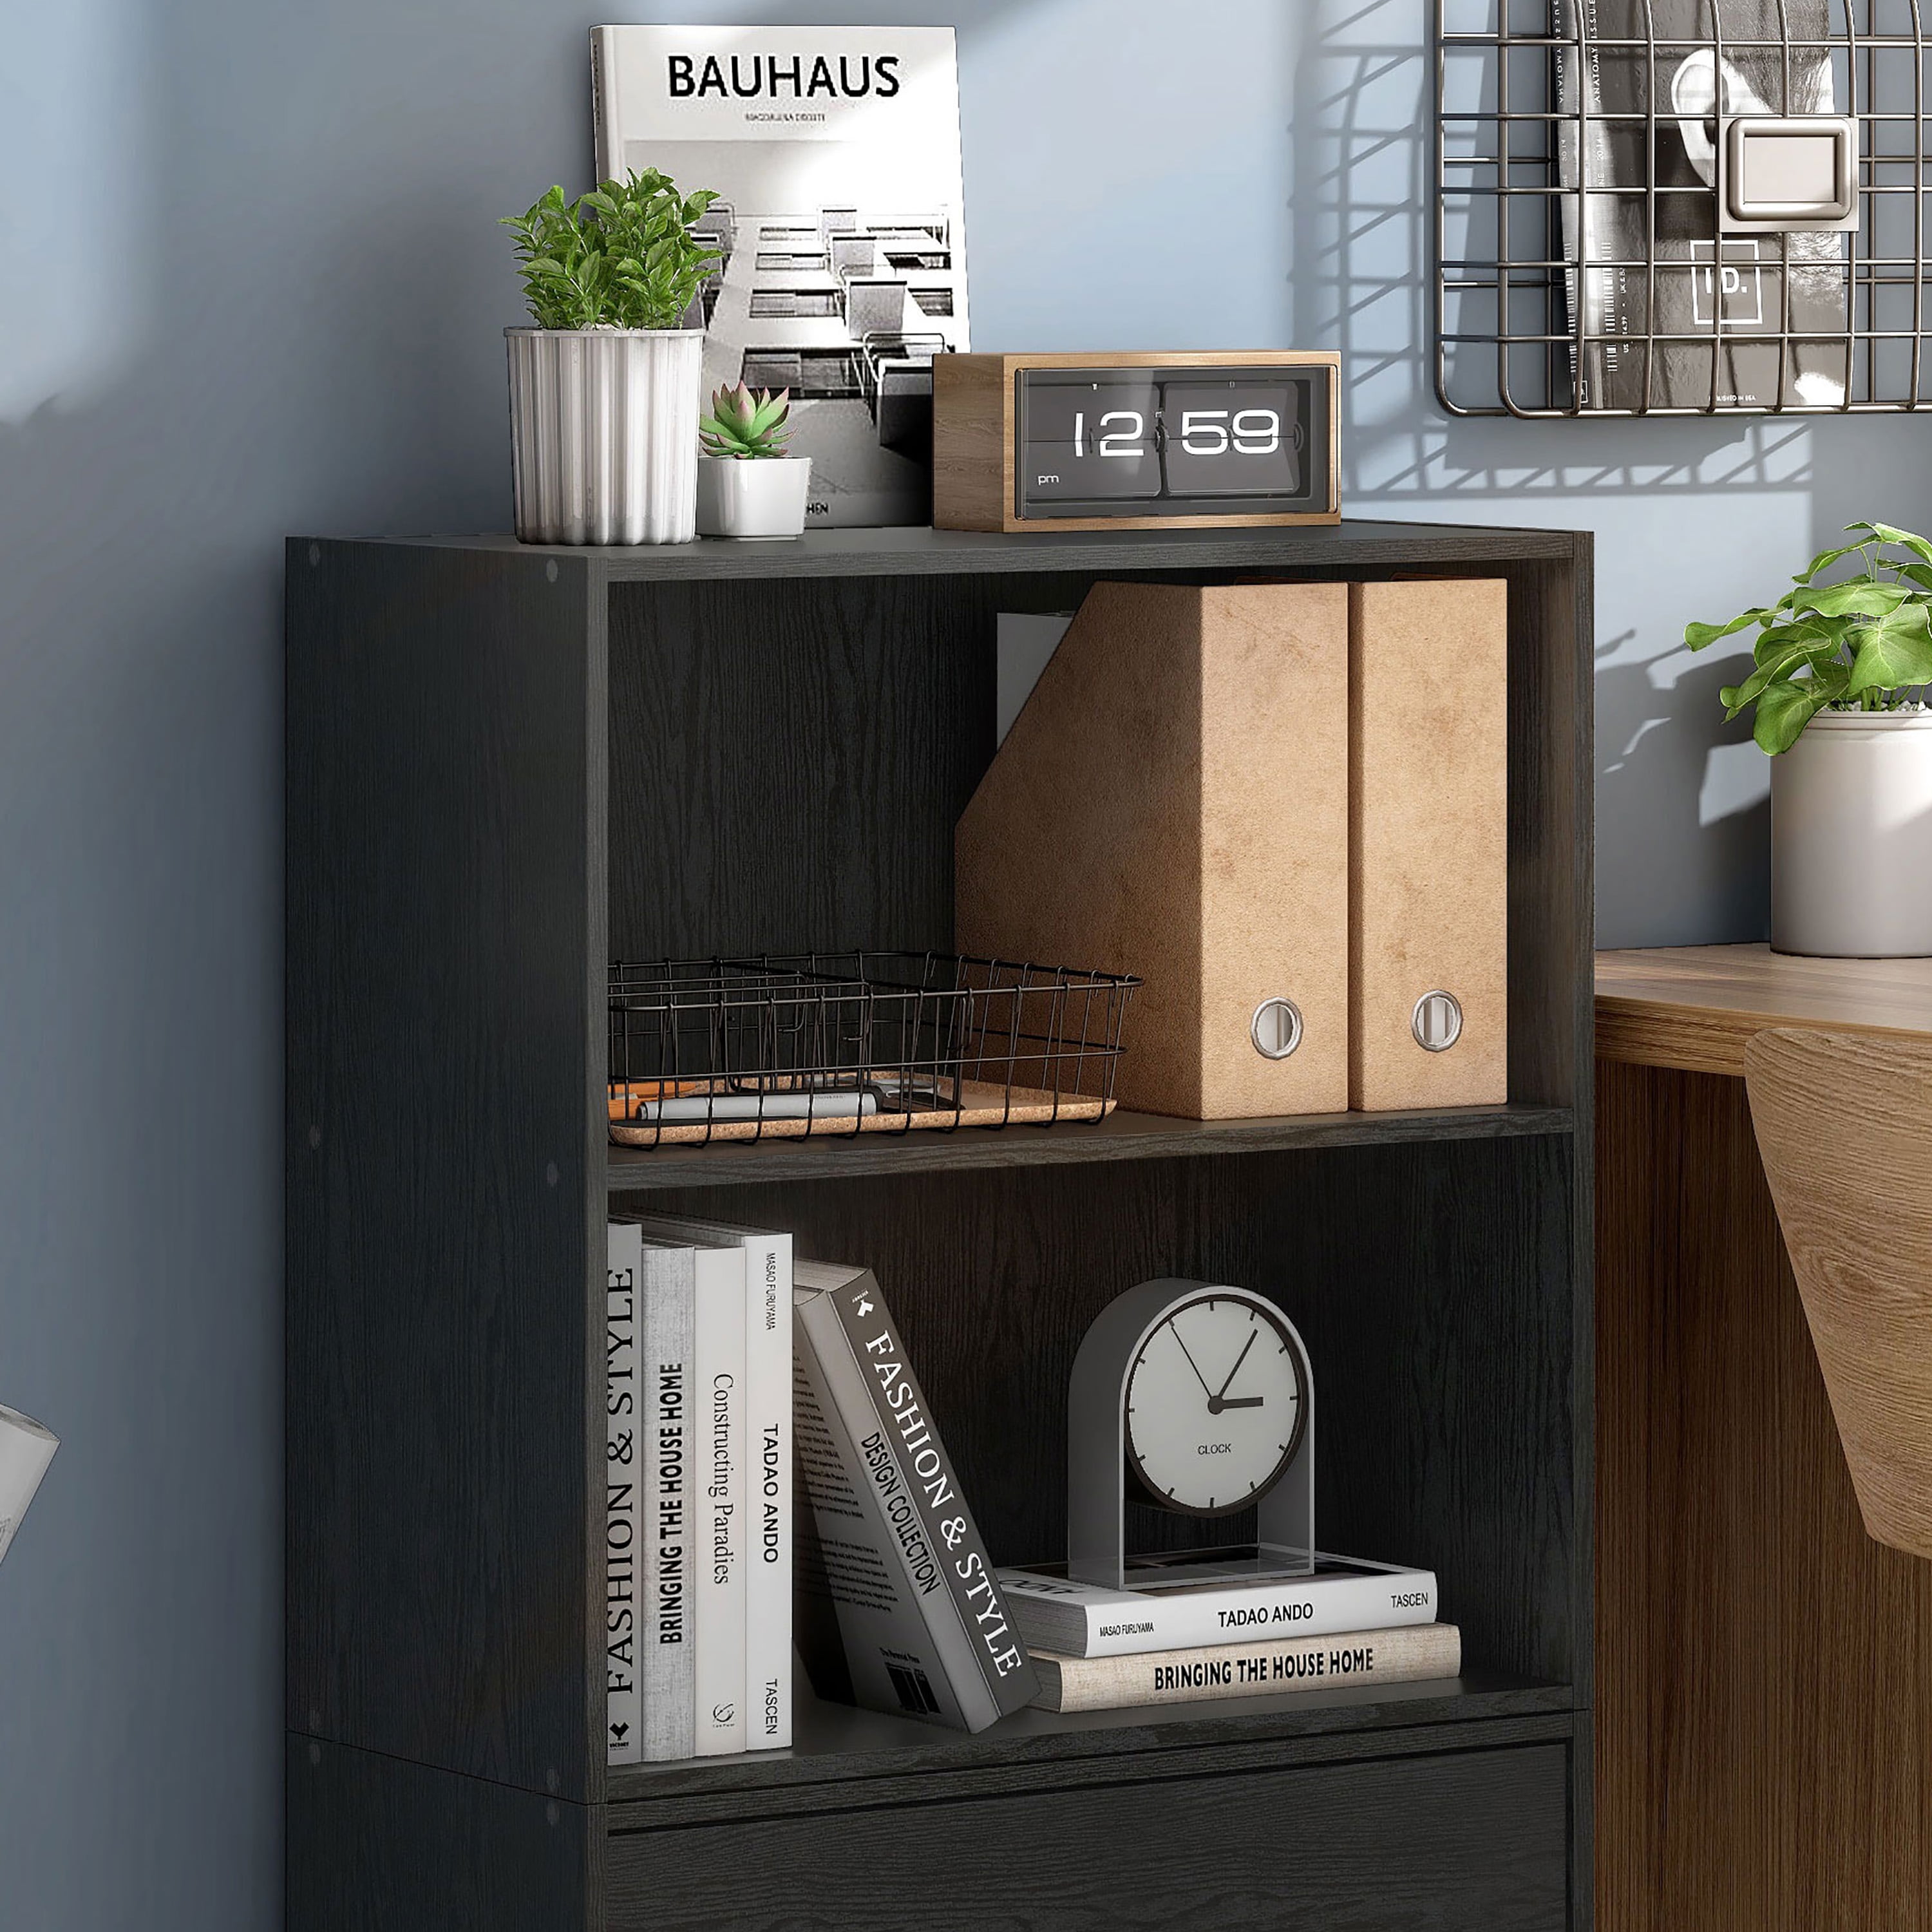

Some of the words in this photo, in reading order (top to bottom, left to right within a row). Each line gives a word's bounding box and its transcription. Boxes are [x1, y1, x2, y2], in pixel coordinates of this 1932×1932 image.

[668, 55, 900, 97] BAUHAUS
[1591, 47, 1601, 104] ANATOMY
[1075, 412, 1144, 457] 12
[1182, 410, 1280, 455] 59
[1038, 475, 1059, 485] pm
[766, 1253, 776, 1282] MASAO
[608, 1267, 633, 1416] STYLE
[659, 1363, 683, 1421] HOME
[608, 1428, 633, 1465] &
[659, 1426, 683, 1493] HOUSE
[708, 1374, 734, 1498] Constructing
[763, 1423, 779, 1497] TADAO
[1197, 1444, 1232, 1455] CLOCK
[659, 1500, 683, 1540] THE
[861, 1431, 901, 1497] DESIGN
[887, 1495, 941, 1596] COLLECTION
[862, 1330, 955, 1509] FASHION
[940, 1516, 967, 1551] &
[955, 1553, 1022, 1677] STYLE
[714, 1503, 734, 1584] Paradies
[763, 1503, 779, 1563] ANDO
[608, 1483, 633, 1694] FASHION
[659, 1546, 683, 1644] BRINGING
[1218, 1607, 1268, 1627] TADAO
[1272, 1603, 1314, 1622] ANDO
[1390, 1592, 1428, 1609] TASCEN
[1099, 1625, 1121, 1637] MASAO
[1155, 1661, 1232, 1690] BRINGING
[1237, 1658, 1267, 1683] THE
[1273, 1653, 1324, 1680] HOUSE
[1330, 1648, 1373, 1675] HOME
[765, 1678, 778, 1734] TASCEN
